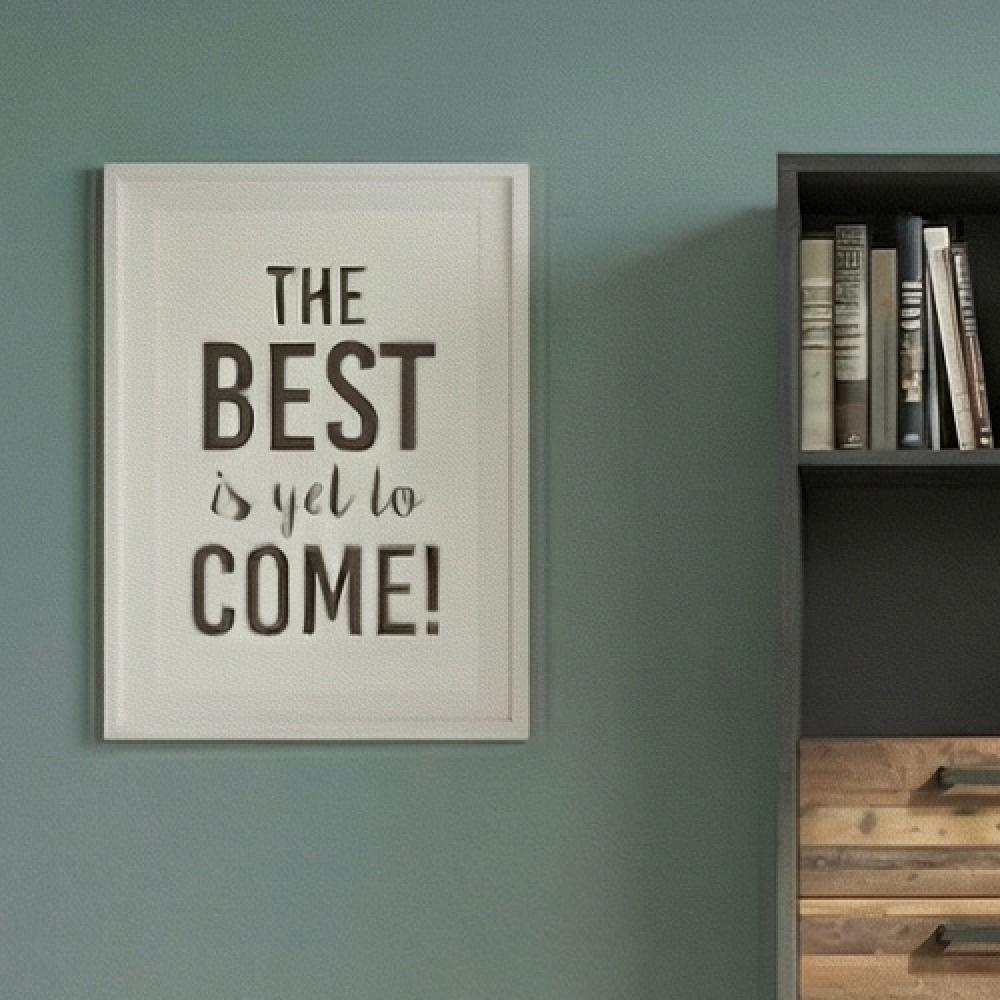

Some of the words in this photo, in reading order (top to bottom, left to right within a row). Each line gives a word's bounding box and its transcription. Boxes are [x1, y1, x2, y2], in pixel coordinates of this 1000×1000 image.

[266, 265, 367, 326] THE
[202, 340, 437, 452] BEST
[210, 470, 252, 521] is
[191, 543, 441, 637] COME!
